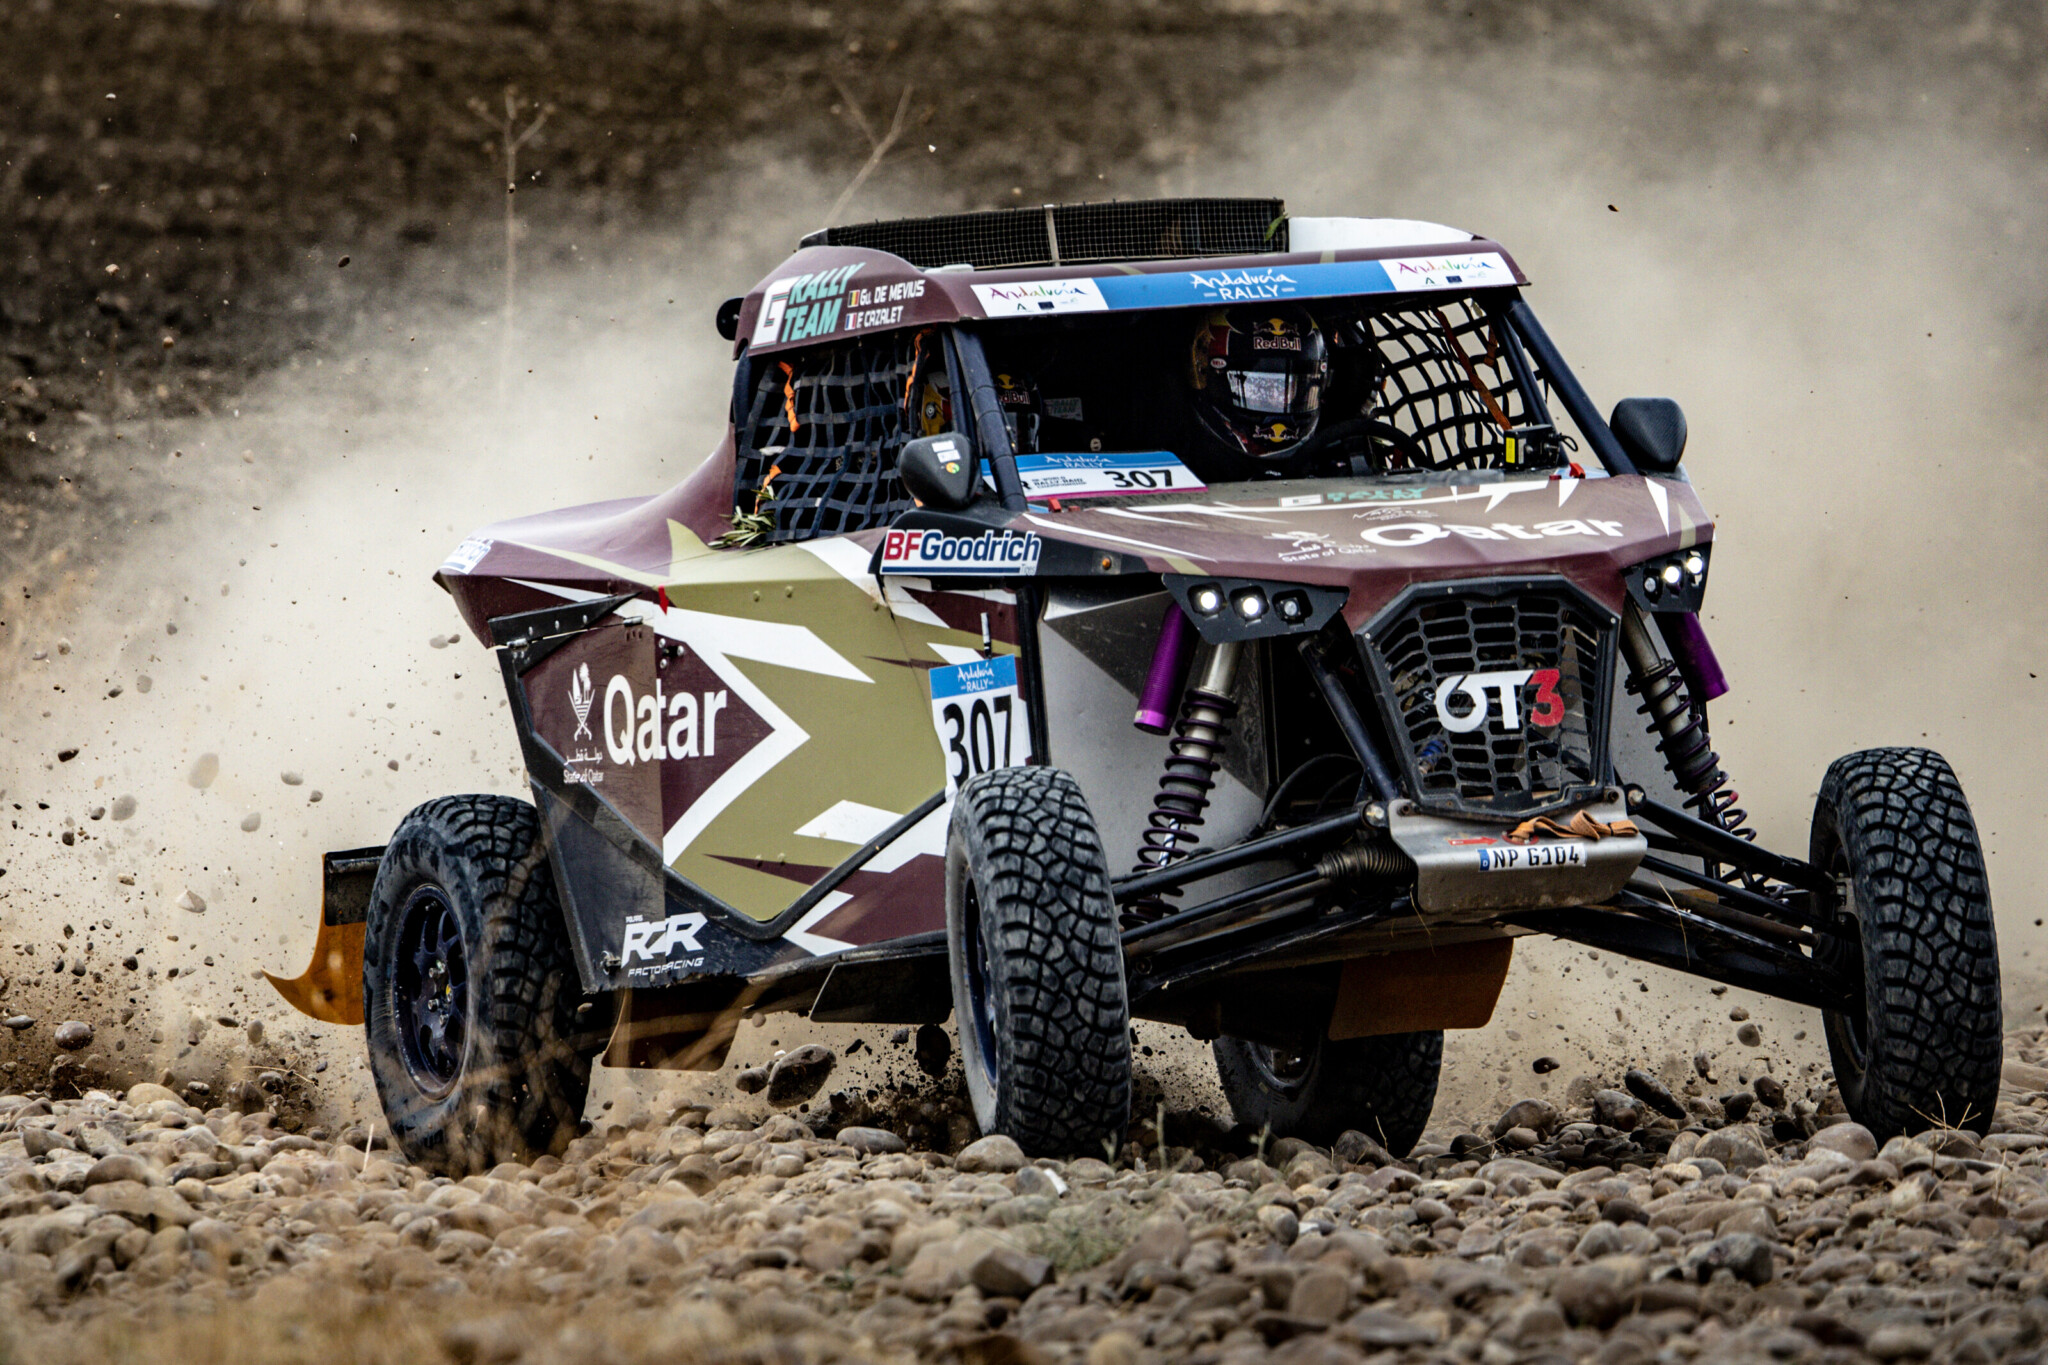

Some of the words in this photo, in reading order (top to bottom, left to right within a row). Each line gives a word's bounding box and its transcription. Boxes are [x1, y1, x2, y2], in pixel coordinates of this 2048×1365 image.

[788, 262, 866, 304] RALLY
[1189, 267, 1298, 289] Andalucía
[873, 285, 888, 304] DE
[888, 279, 926, 302] MEVIUS
[1218, 284, 1279, 300] RALLY
[781, 298, 843, 343] TEAM
[864, 305, 904, 328] CAZALET
[1103, 469, 1173, 488] 307
[1360, 518, 1624, 547] Qatar
[884, 530, 1040, 562] BFGoodrich
[1282, 553, 1320, 563] State
[1322, 548, 1336, 558] of
[966, 678, 990, 692] RALLY
[603, 674, 728, 767] Qatar
[943, 693, 1012, 790] 307
[1493, 848, 1519, 869] NP
